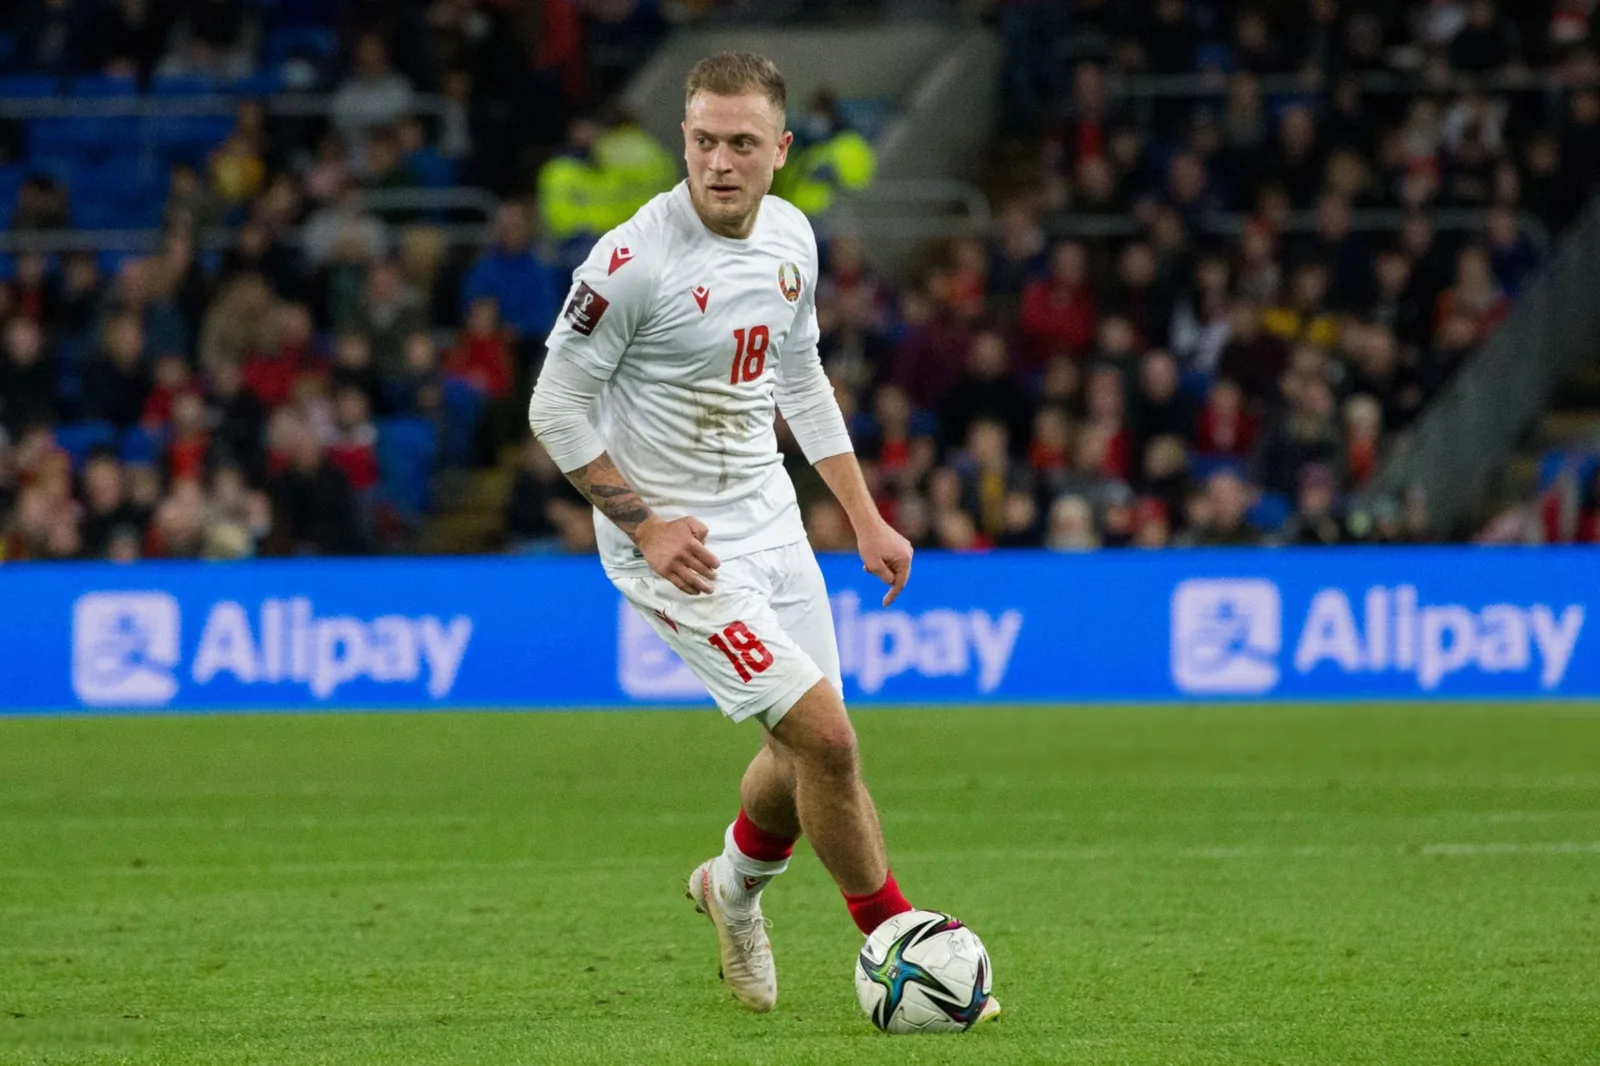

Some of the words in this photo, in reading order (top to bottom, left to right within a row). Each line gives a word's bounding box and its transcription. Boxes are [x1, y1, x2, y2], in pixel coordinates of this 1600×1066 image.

[729, 324, 770, 386] 18
[192, 597, 472, 698] Alipay
[708, 620, 774, 683] 18
[1295, 585, 1584, 689] Alipay
